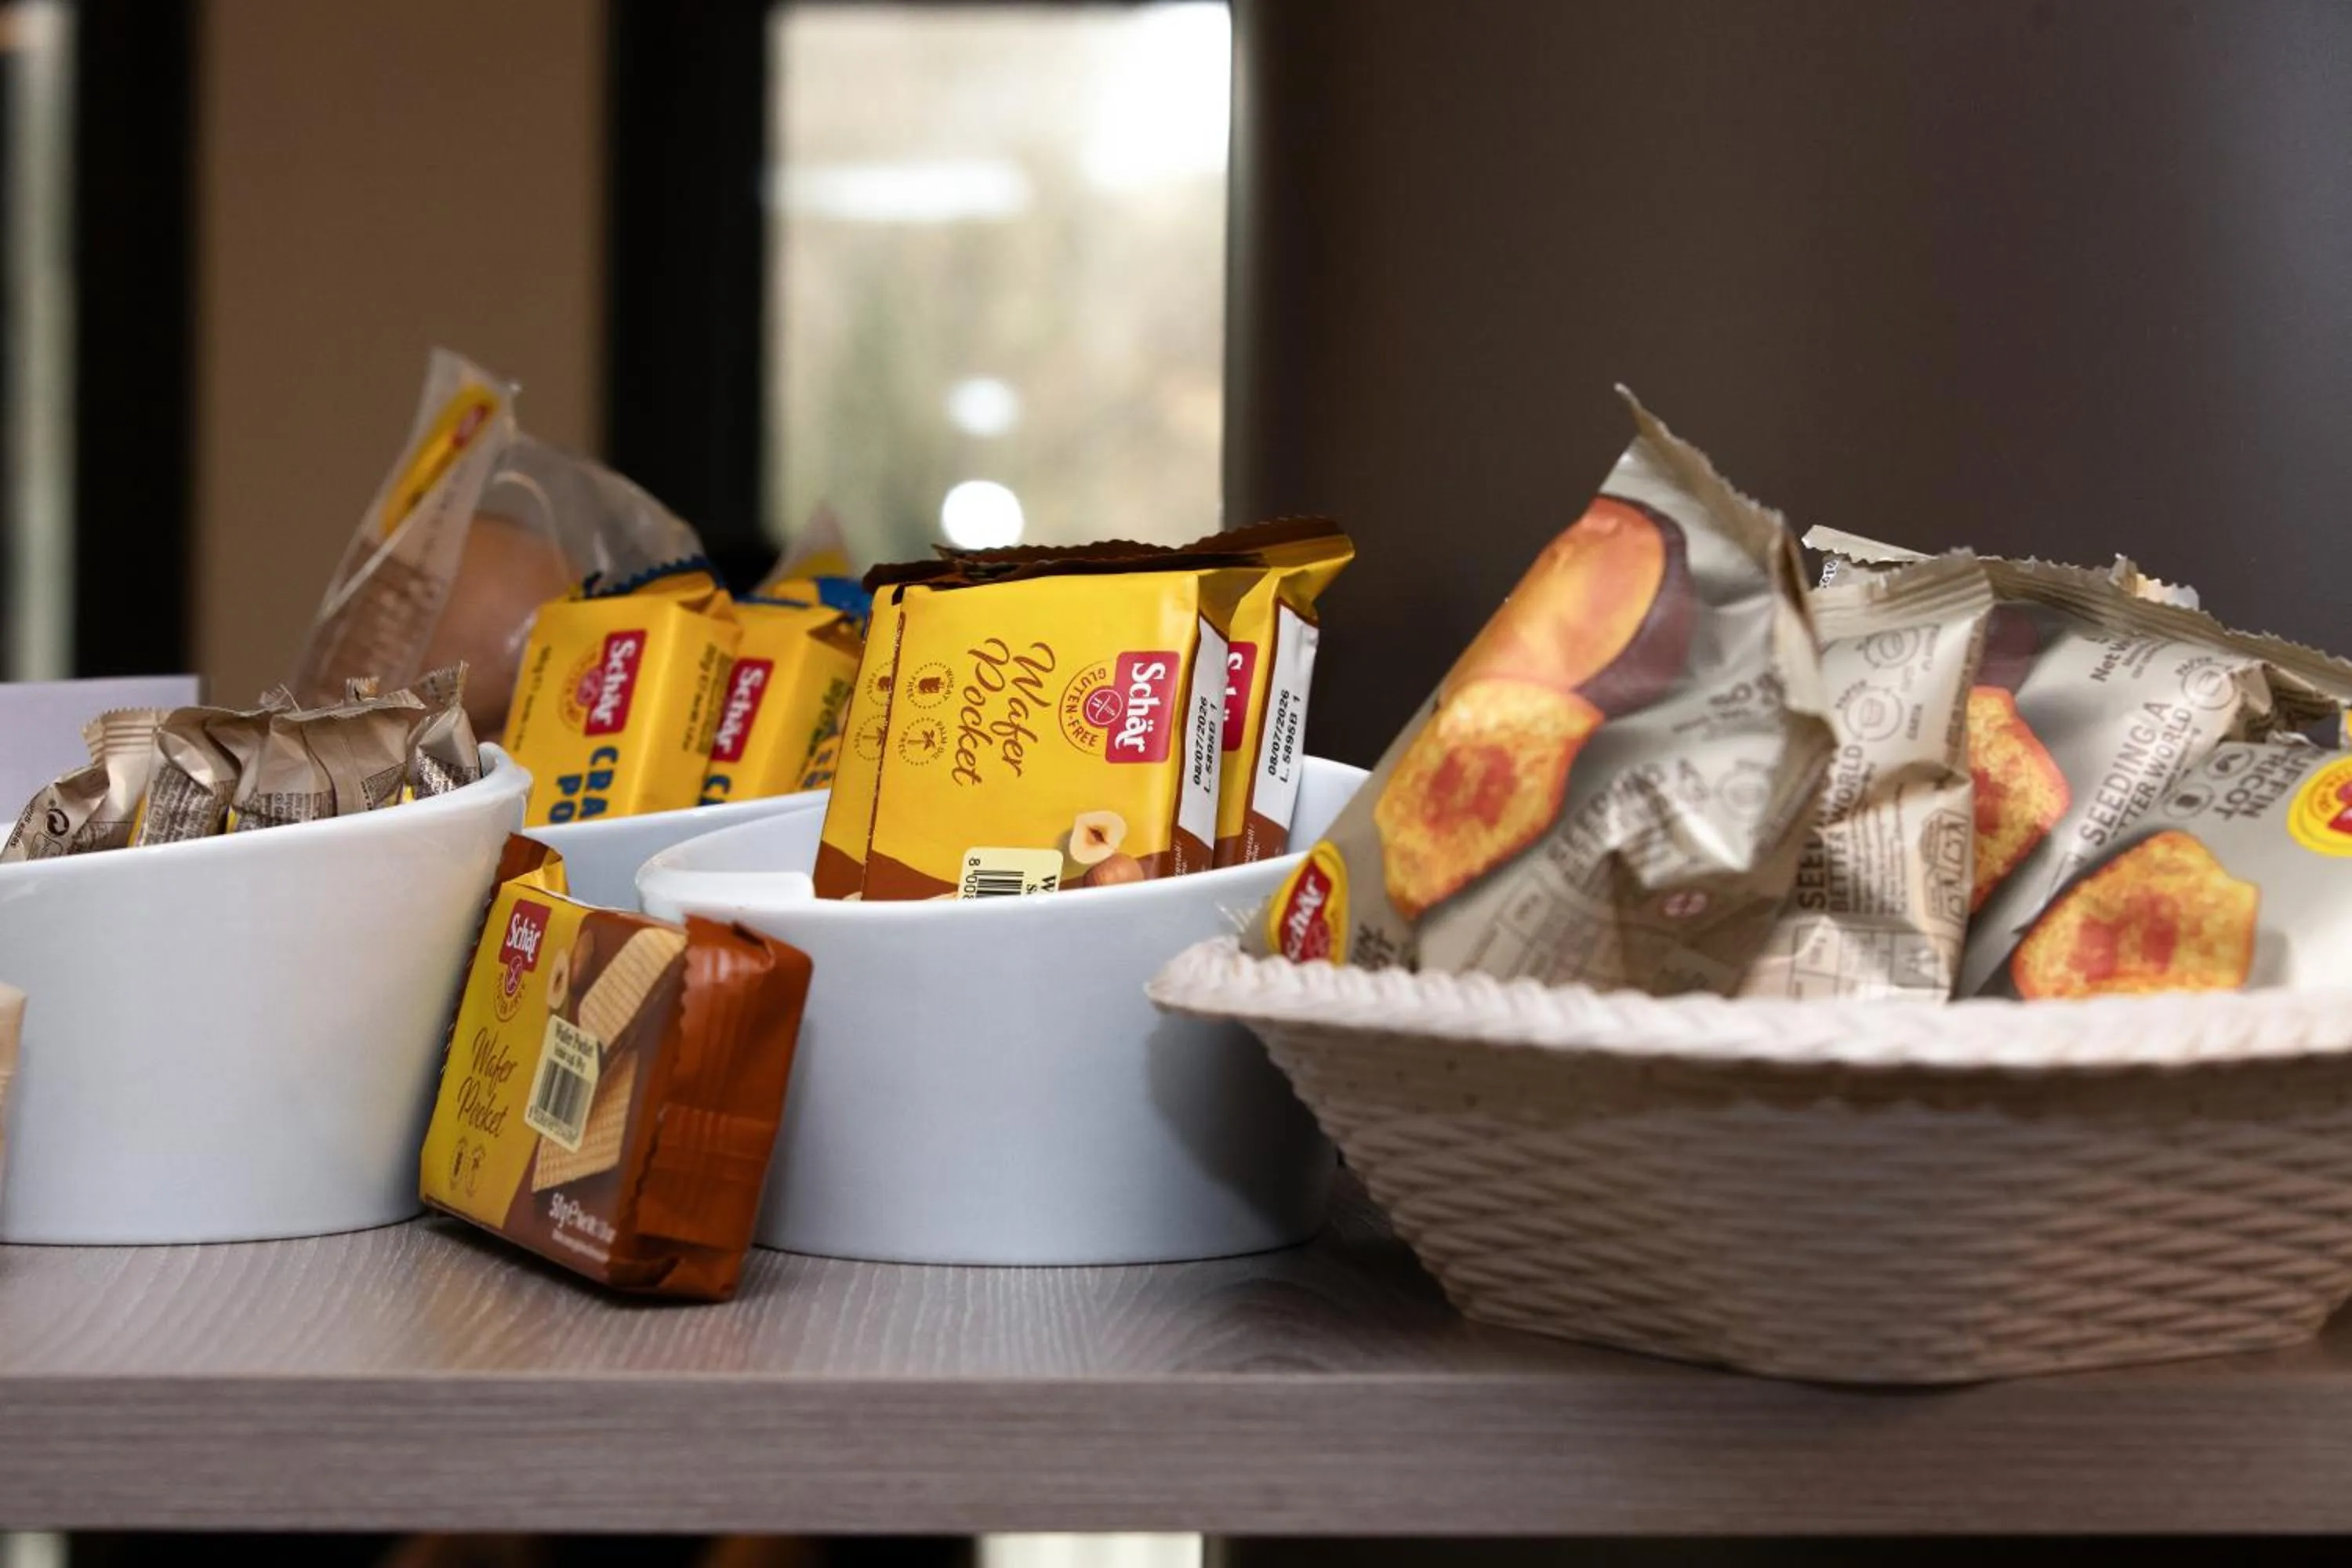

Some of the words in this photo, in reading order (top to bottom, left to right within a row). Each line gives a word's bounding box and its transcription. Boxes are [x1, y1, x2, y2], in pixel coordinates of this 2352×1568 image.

[590, 638, 637, 727] Schär
[716, 666, 765, 755] Schär
[952, 637, 1010, 786] Pocket
[989, 642, 1056, 778] Wafer
[1115, 662, 1167, 753] Schär
[1192, 695, 1209, 786] 08/07/2026
[1268, 688, 1290, 776] 08/07/2026
[2079, 724, 2157, 847] SEEDING
[2142, 701, 2173, 722] A
[2145, 707, 2193, 779] WORLD
[2239, 753, 2311, 818] UFFIN
[506, 913, 543, 964] Schär
[472, 1027, 519, 1097] Wafer
[457, 1076, 510, 1138] Pocket
